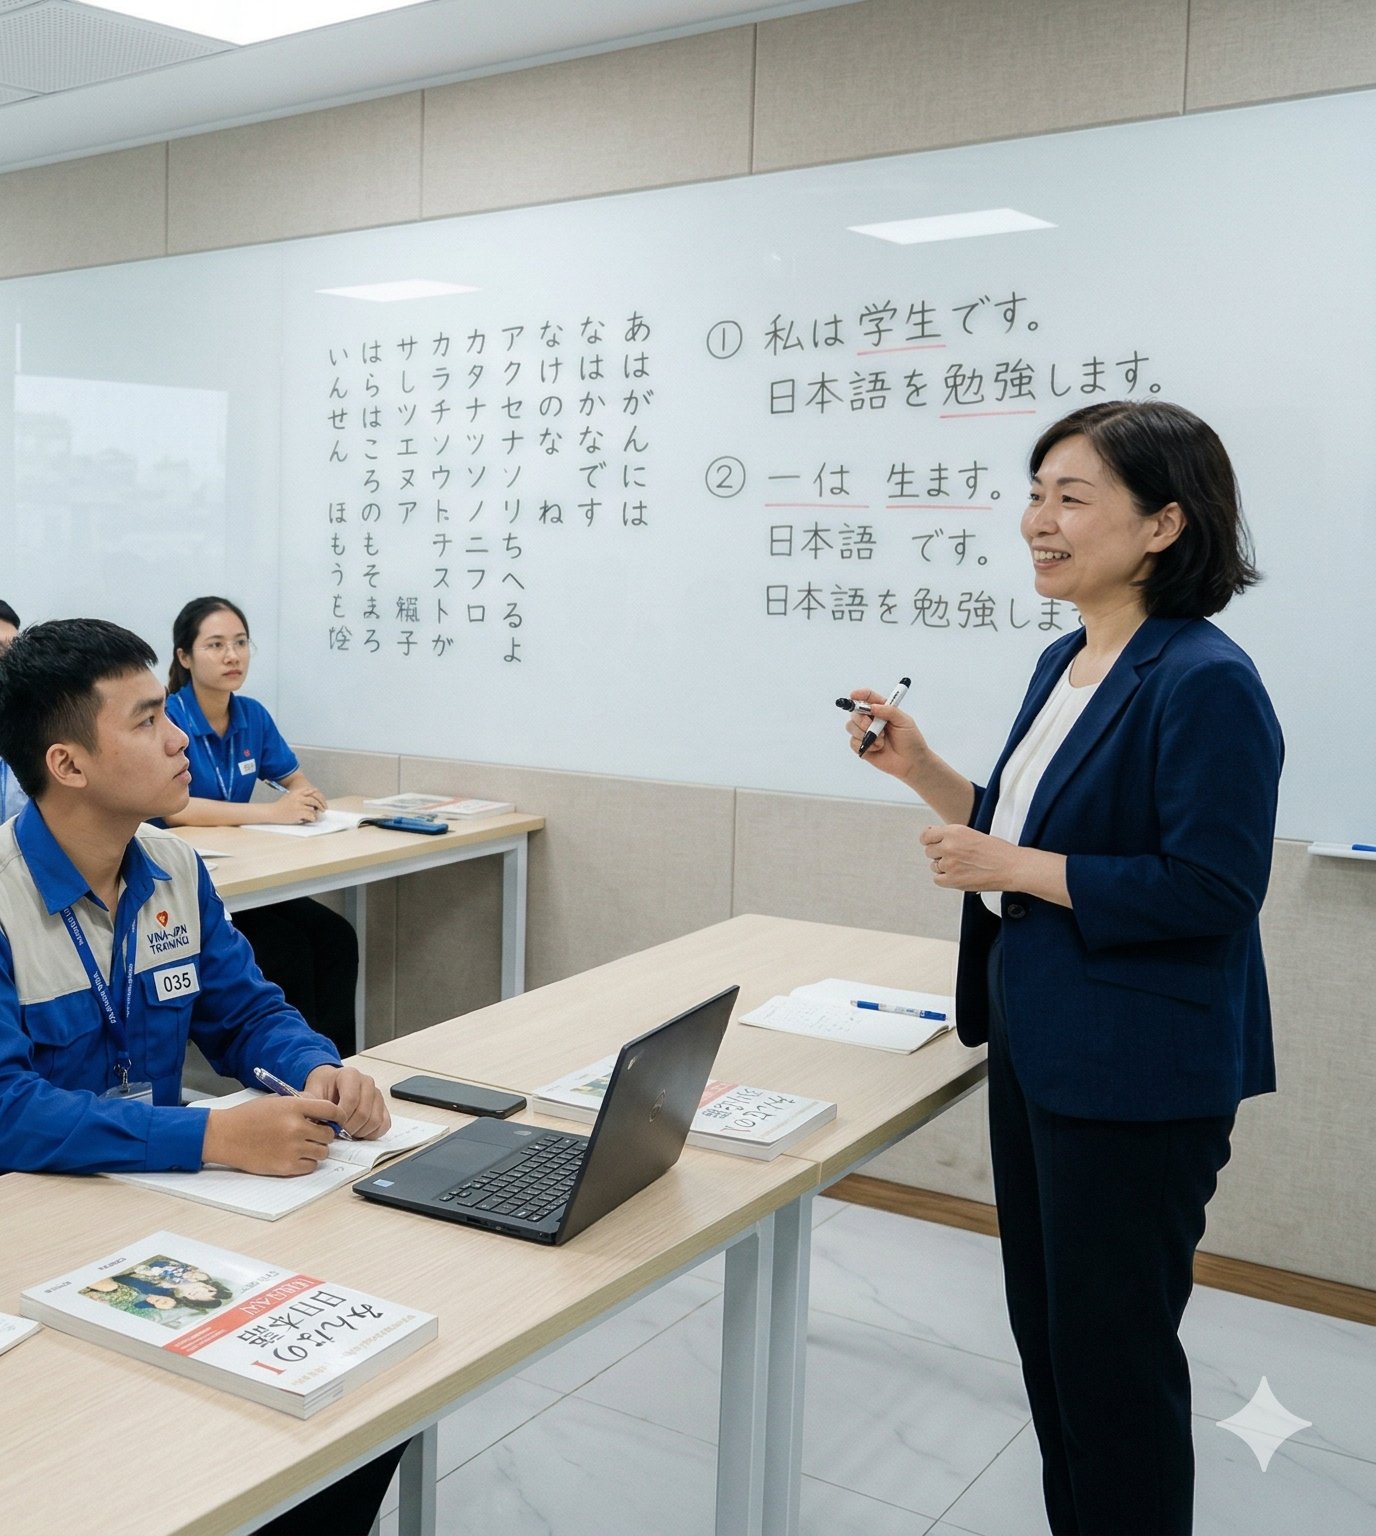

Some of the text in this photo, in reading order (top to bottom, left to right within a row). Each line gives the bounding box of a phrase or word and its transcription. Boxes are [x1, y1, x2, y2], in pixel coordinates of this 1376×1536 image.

[764, 291, 1040, 356] 私は学生です。
[769, 350, 1161, 415] 日本語を勉強します。
[769, 521, 988, 566] 日本語 です。
[163, 971, 192, 993] 035
[273, 1303, 384, 1363] みんなの
